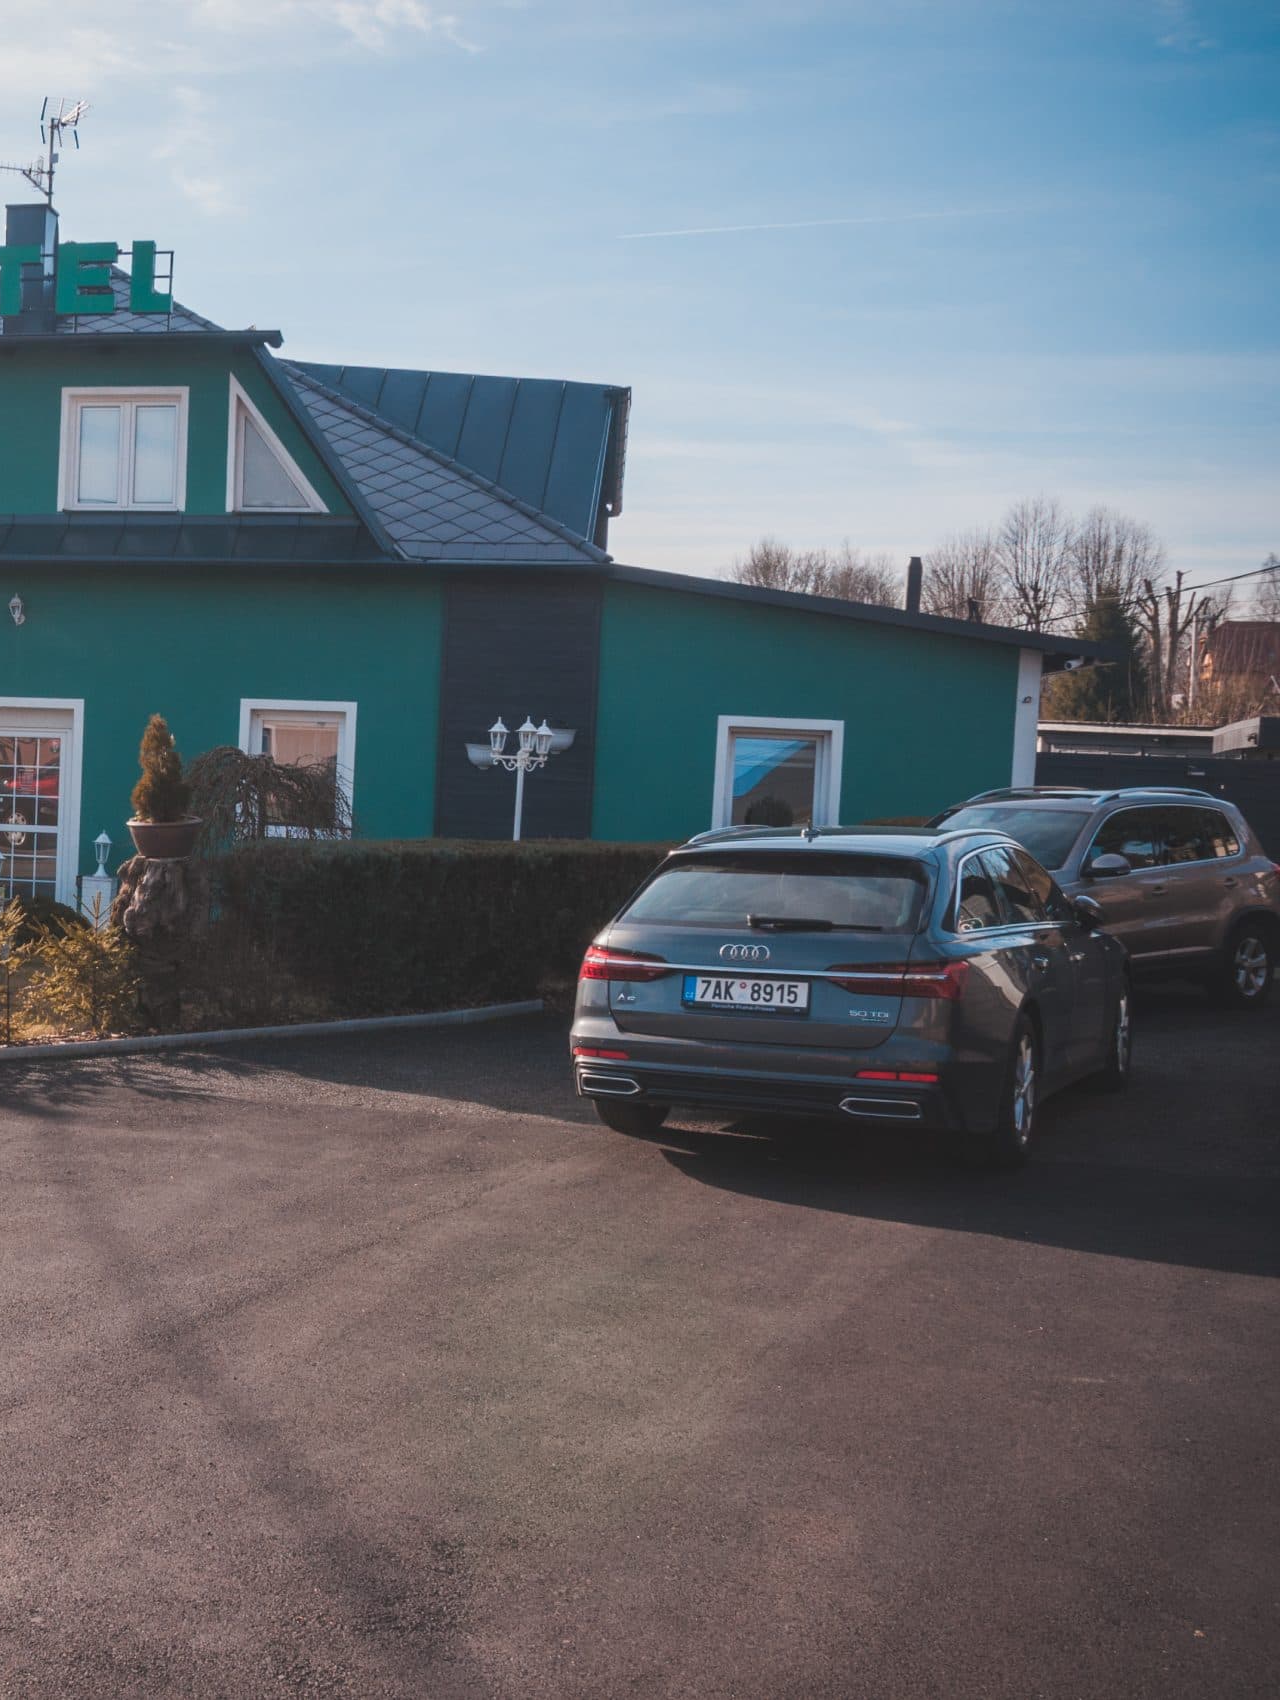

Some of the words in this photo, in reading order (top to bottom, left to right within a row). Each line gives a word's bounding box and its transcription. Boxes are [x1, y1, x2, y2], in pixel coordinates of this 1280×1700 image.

[700, 979, 735, 1001] 7AK
[750, 982, 799, 1004] 8915
[849, 1009, 867, 1017] 50
